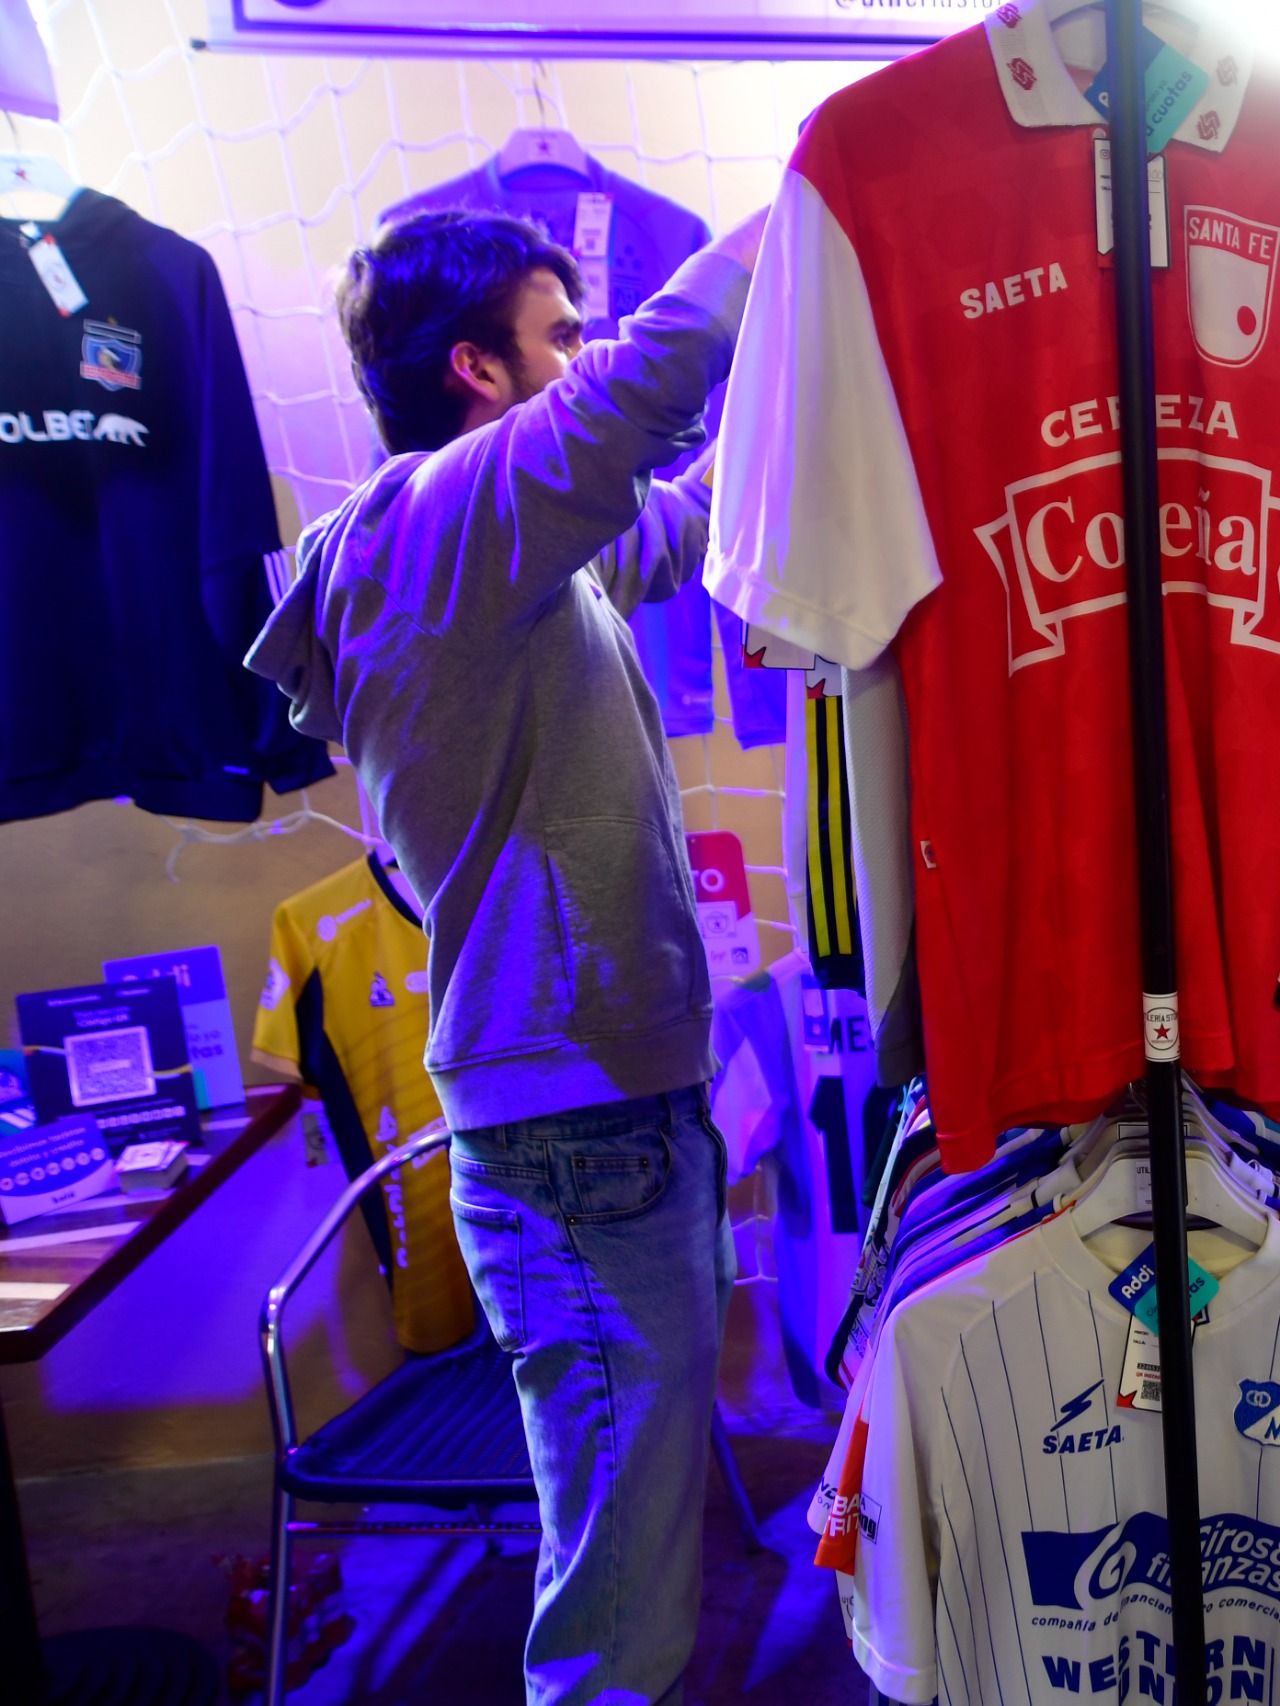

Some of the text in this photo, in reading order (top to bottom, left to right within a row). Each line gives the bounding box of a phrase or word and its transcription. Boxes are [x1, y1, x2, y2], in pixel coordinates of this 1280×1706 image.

[1152, 71, 1193, 124] cuotas
[1189, 215, 1274, 260] SANTA FE
[959, 262, 1069, 320] SAETA
[1041, 395, 1240, 448] CEEZA
[1025, 486, 1257, 583] Coeña
[829, 1016, 874, 1054] ME
[1121, 1264, 1155, 1299] Addi
[1042, 1424, 1122, 1454] SAETA
[1031, 1616, 1096, 1632] compañía
[1103, 1611, 1119, 1626] de
[1118, 1665, 1264, 1706] UNON
